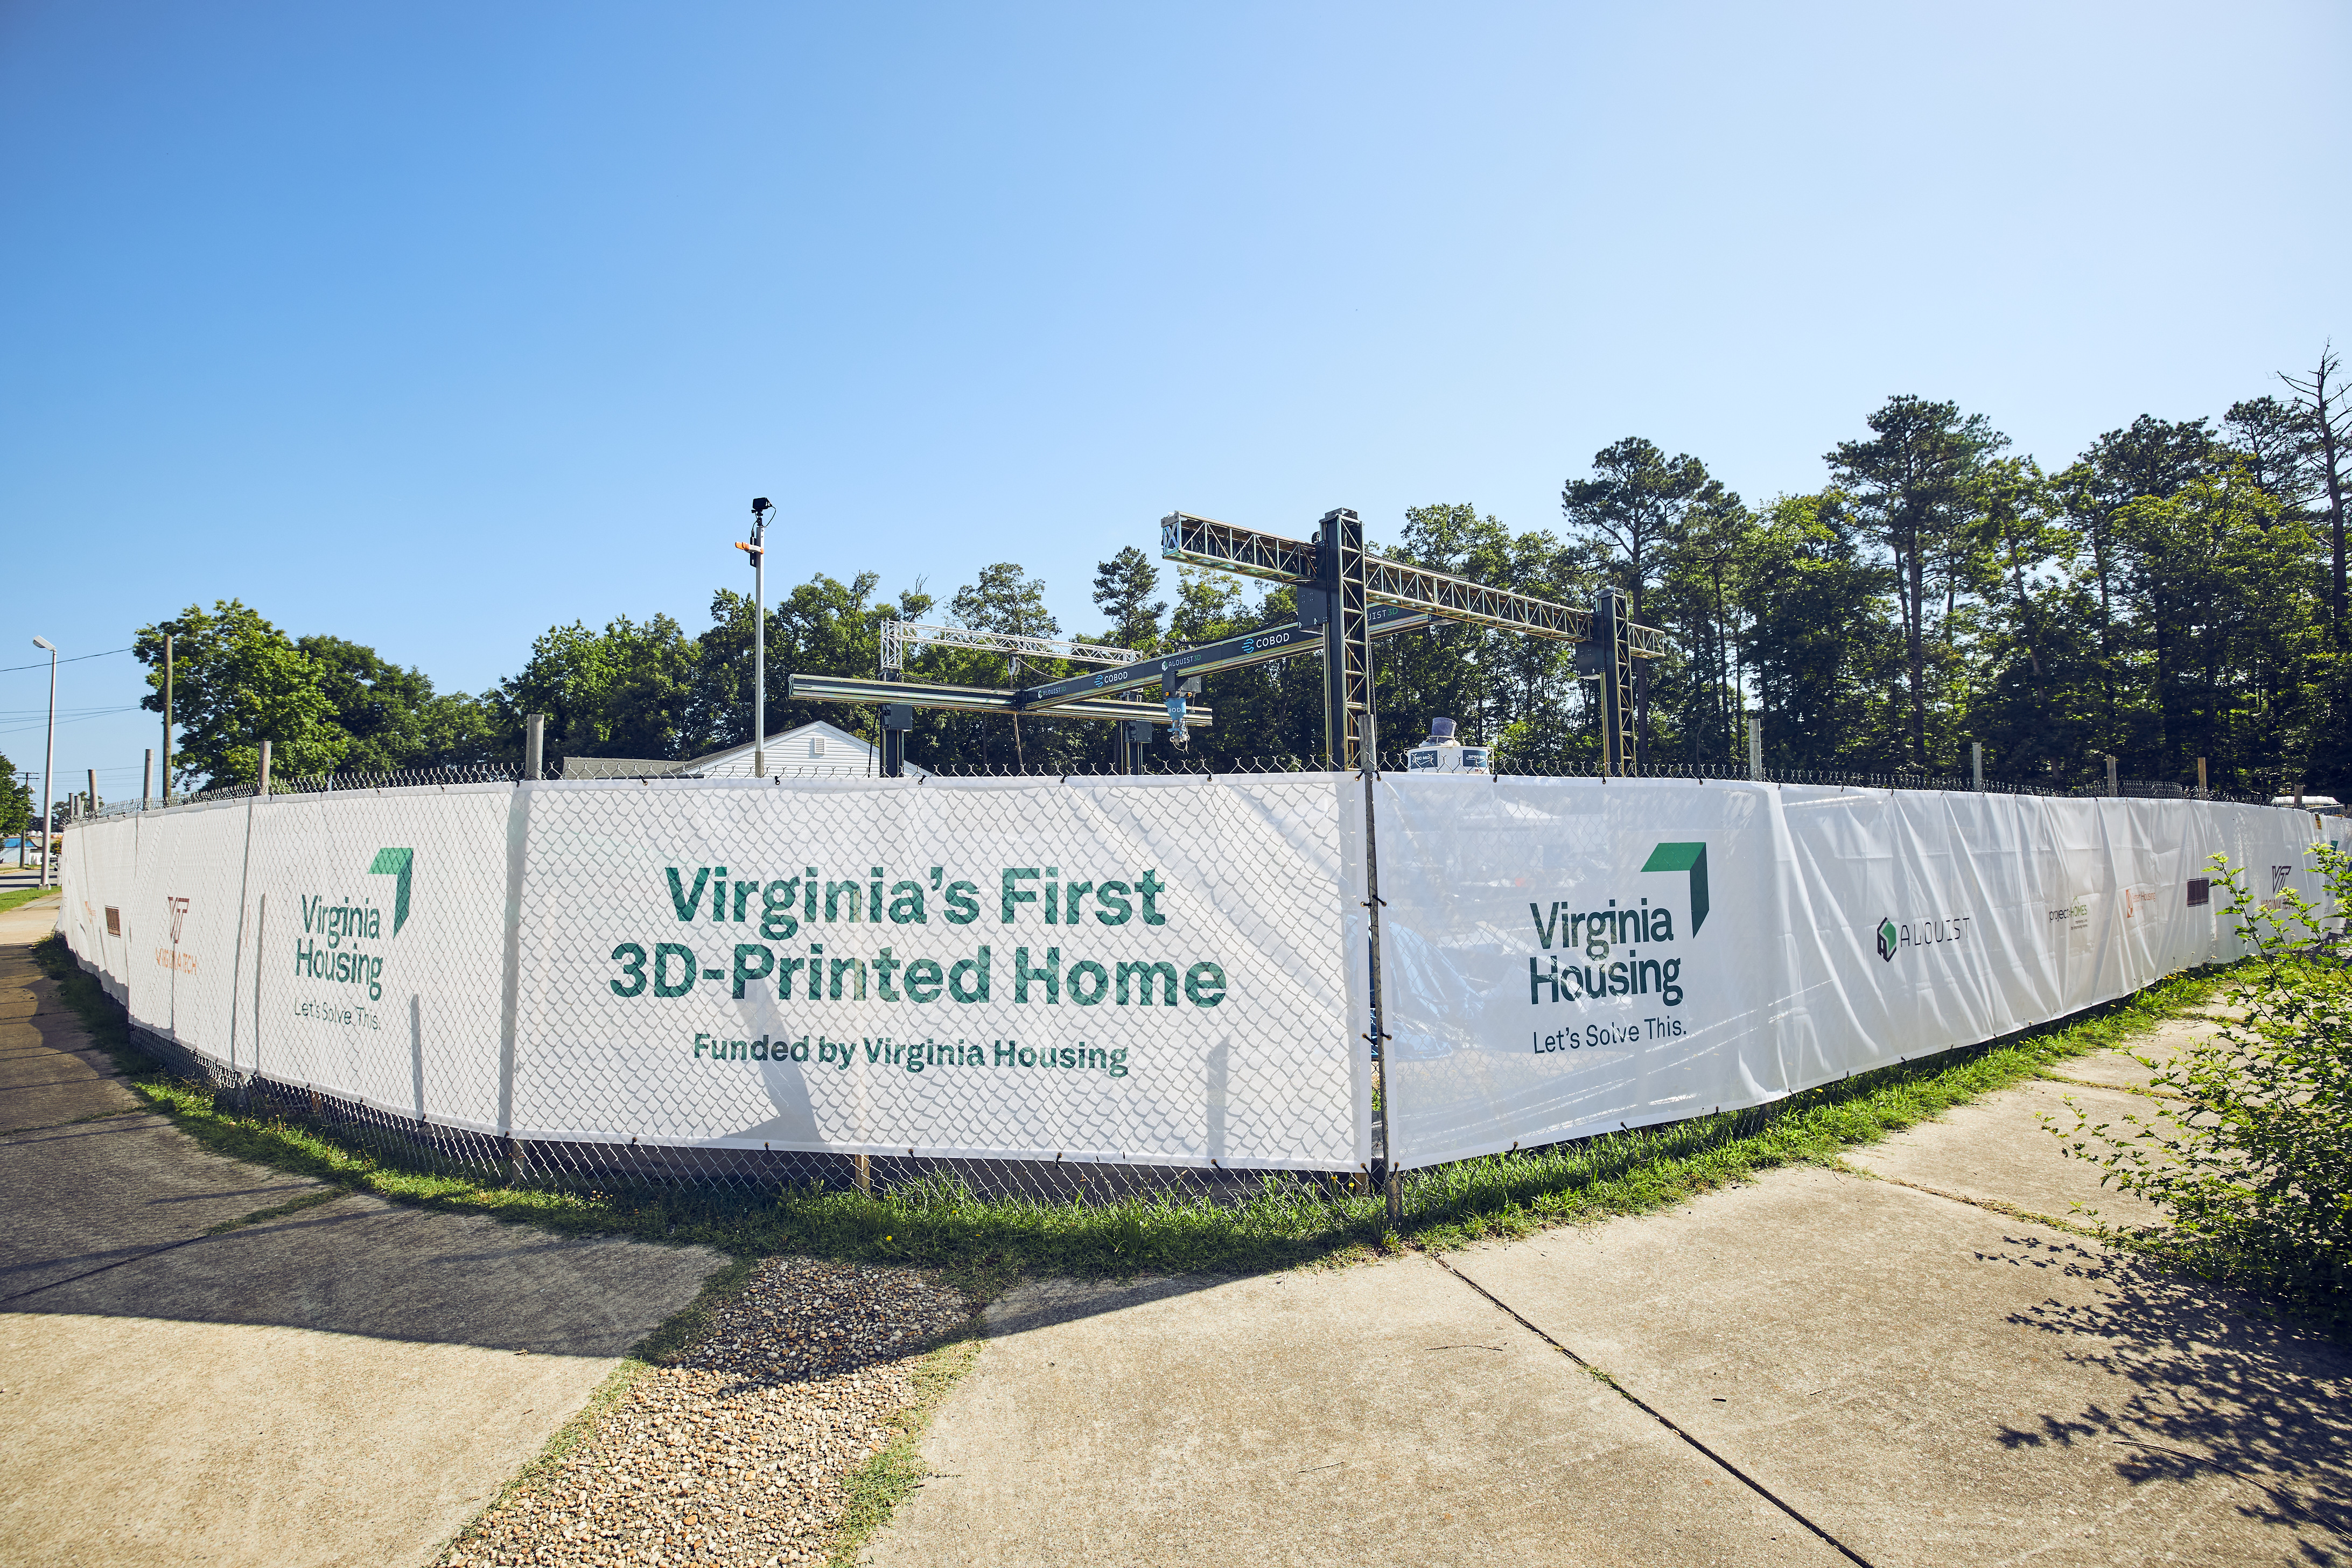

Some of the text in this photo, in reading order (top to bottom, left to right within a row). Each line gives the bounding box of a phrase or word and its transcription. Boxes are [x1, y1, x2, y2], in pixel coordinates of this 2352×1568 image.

[1256, 633, 1290, 648] COBOD
[1104, 671, 1128, 684] COBOD
[302, 894, 380, 949] Virginia
[666, 866, 1166, 940] Virginia's First
[1529, 898, 1674, 961] Virginia
[1900, 918, 1970, 947] ALQUIST
[296, 938, 383, 1001] Housing
[609, 942, 1227, 1007] 3D-Printed Home
[1530, 949, 1683, 1006] Housing
[295, 998, 381, 1031] Let's Solve This.
[1534, 1016, 1687, 1054] Let's Solve This.
[693, 1033, 1129, 1078] Funded by Virginia Housing
